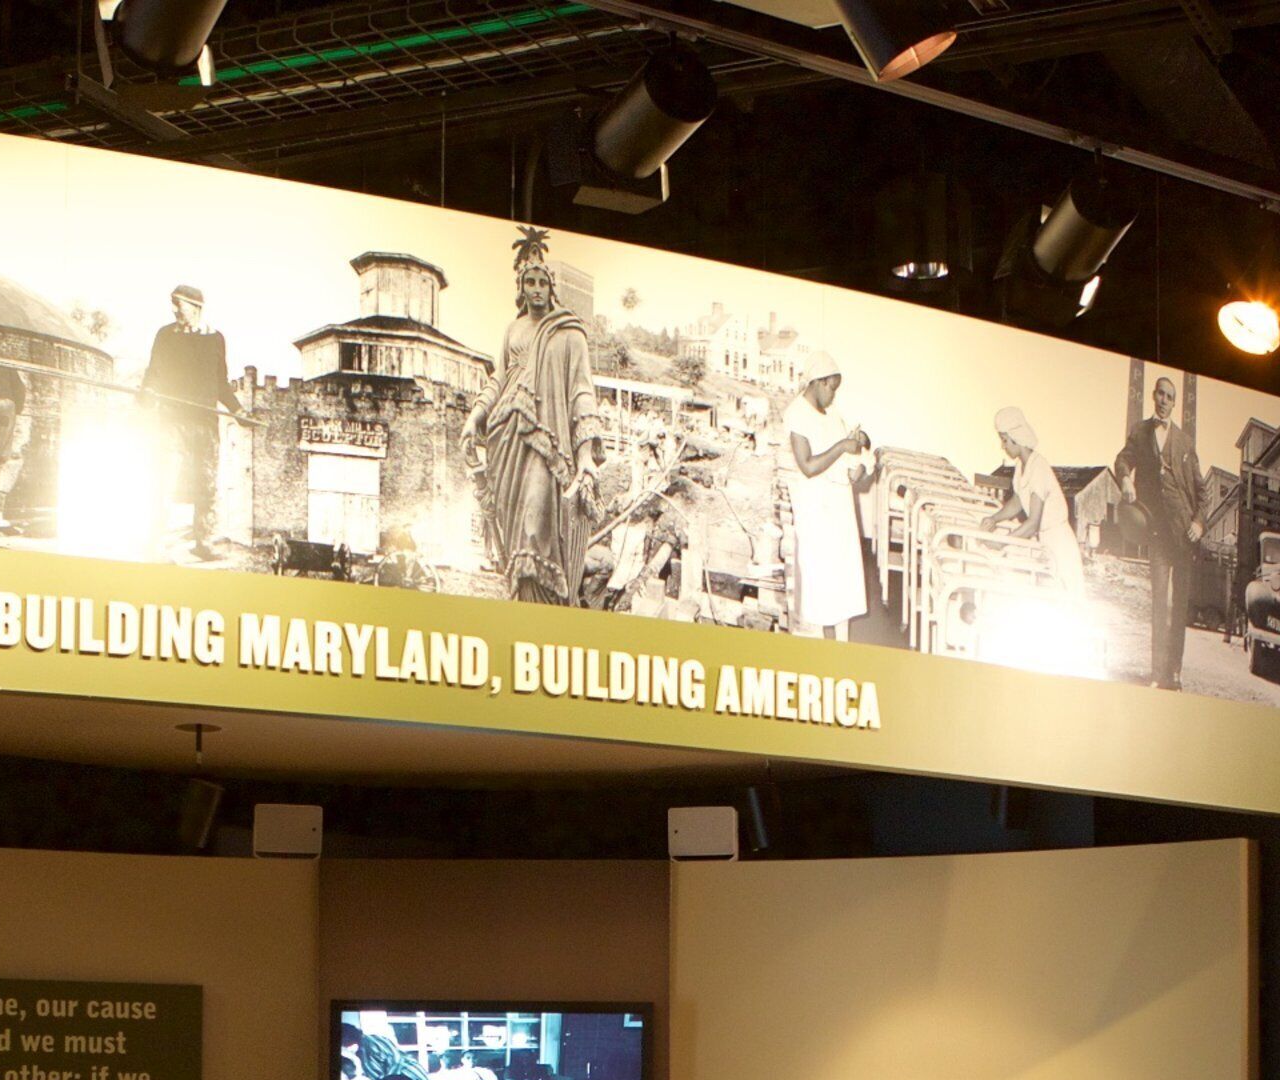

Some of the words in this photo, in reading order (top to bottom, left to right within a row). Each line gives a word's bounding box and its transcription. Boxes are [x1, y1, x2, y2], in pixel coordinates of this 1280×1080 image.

[238, 614, 503, 696] MARYLAND,
[512, 642, 707, 711] BUILDING
[714, 666, 882, 730] AMERICA
[36, 997, 78, 1018] our
[86, 998, 157, 1020] cause
[21, 1031, 55, 1053] we
[64, 1031, 127, 1055] must
